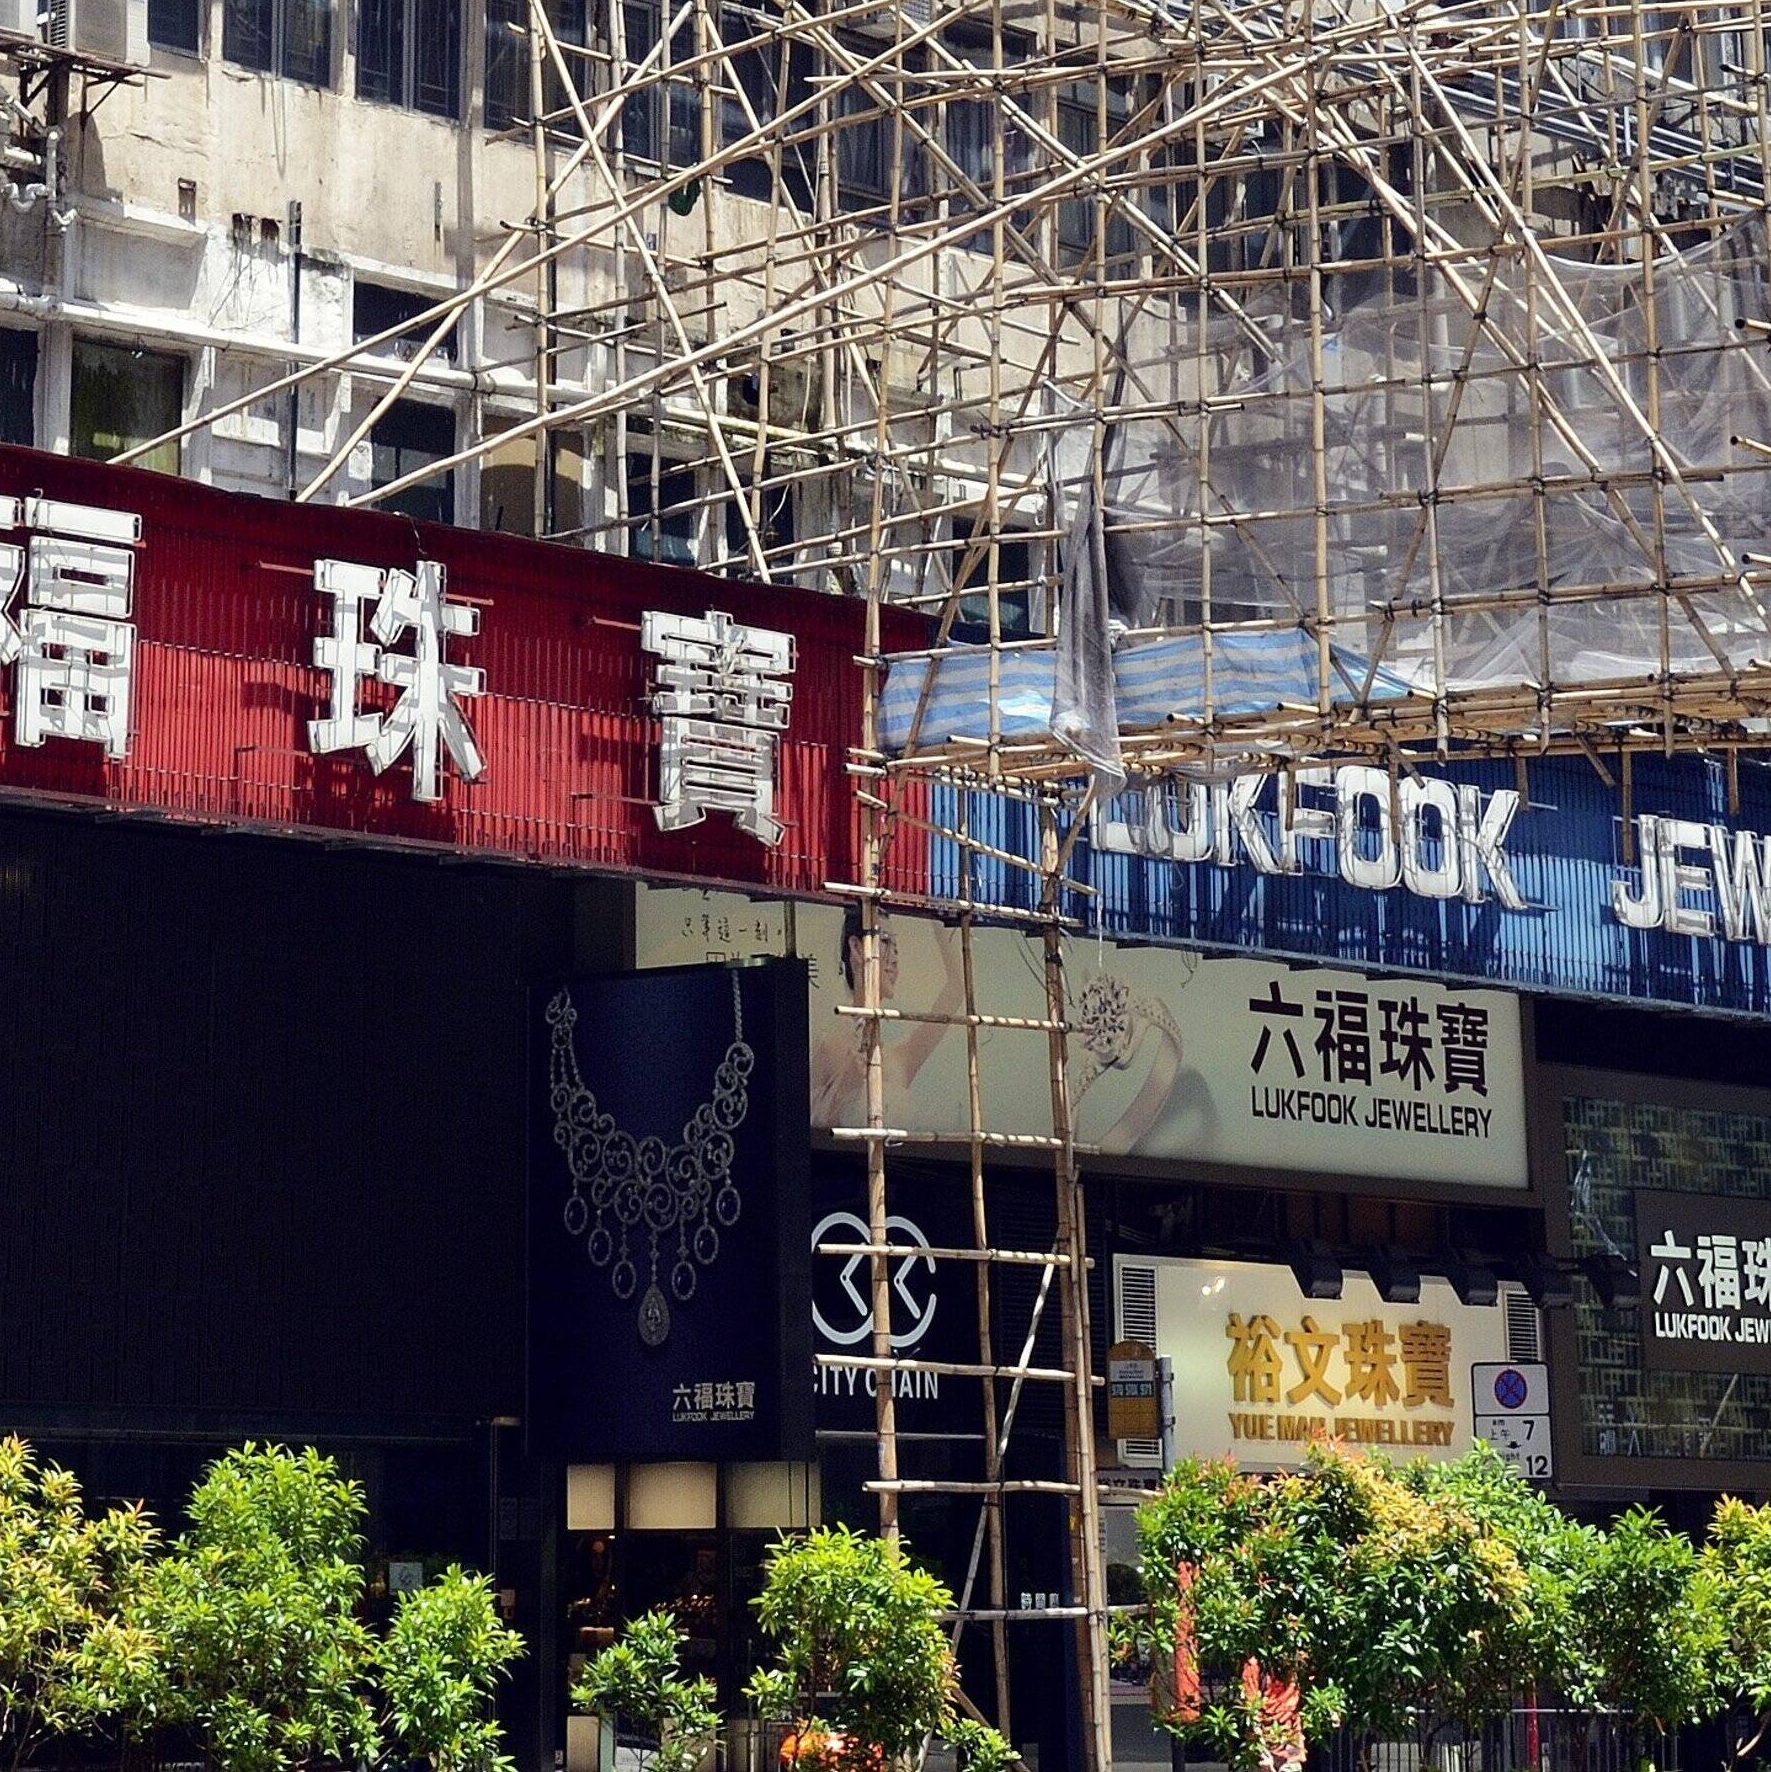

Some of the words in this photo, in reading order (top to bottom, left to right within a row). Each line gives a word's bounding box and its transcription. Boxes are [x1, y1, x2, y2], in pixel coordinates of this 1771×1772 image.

[1090, 764, 1528, 912] LUKFOOK
[1249, 981, 1491, 1098] 六福珠寶
[1251, 1084, 1358, 1127] LUKFOOK
[1364, 1095, 1492, 1139] JEWELLERY
[1654, 1311, 1732, 1342] LUKFOOK
[1225, 1312, 1456, 1410] 裕文珠寶
[672, 1381, 755, 1411] 六福珠寶
[813, 1365, 857, 1396] ITY
[1227, 1412, 1276, 1441] YUE
[1522, 1420, 1535, 1441] 7
[1526, 1455, 1548, 1476] 12
